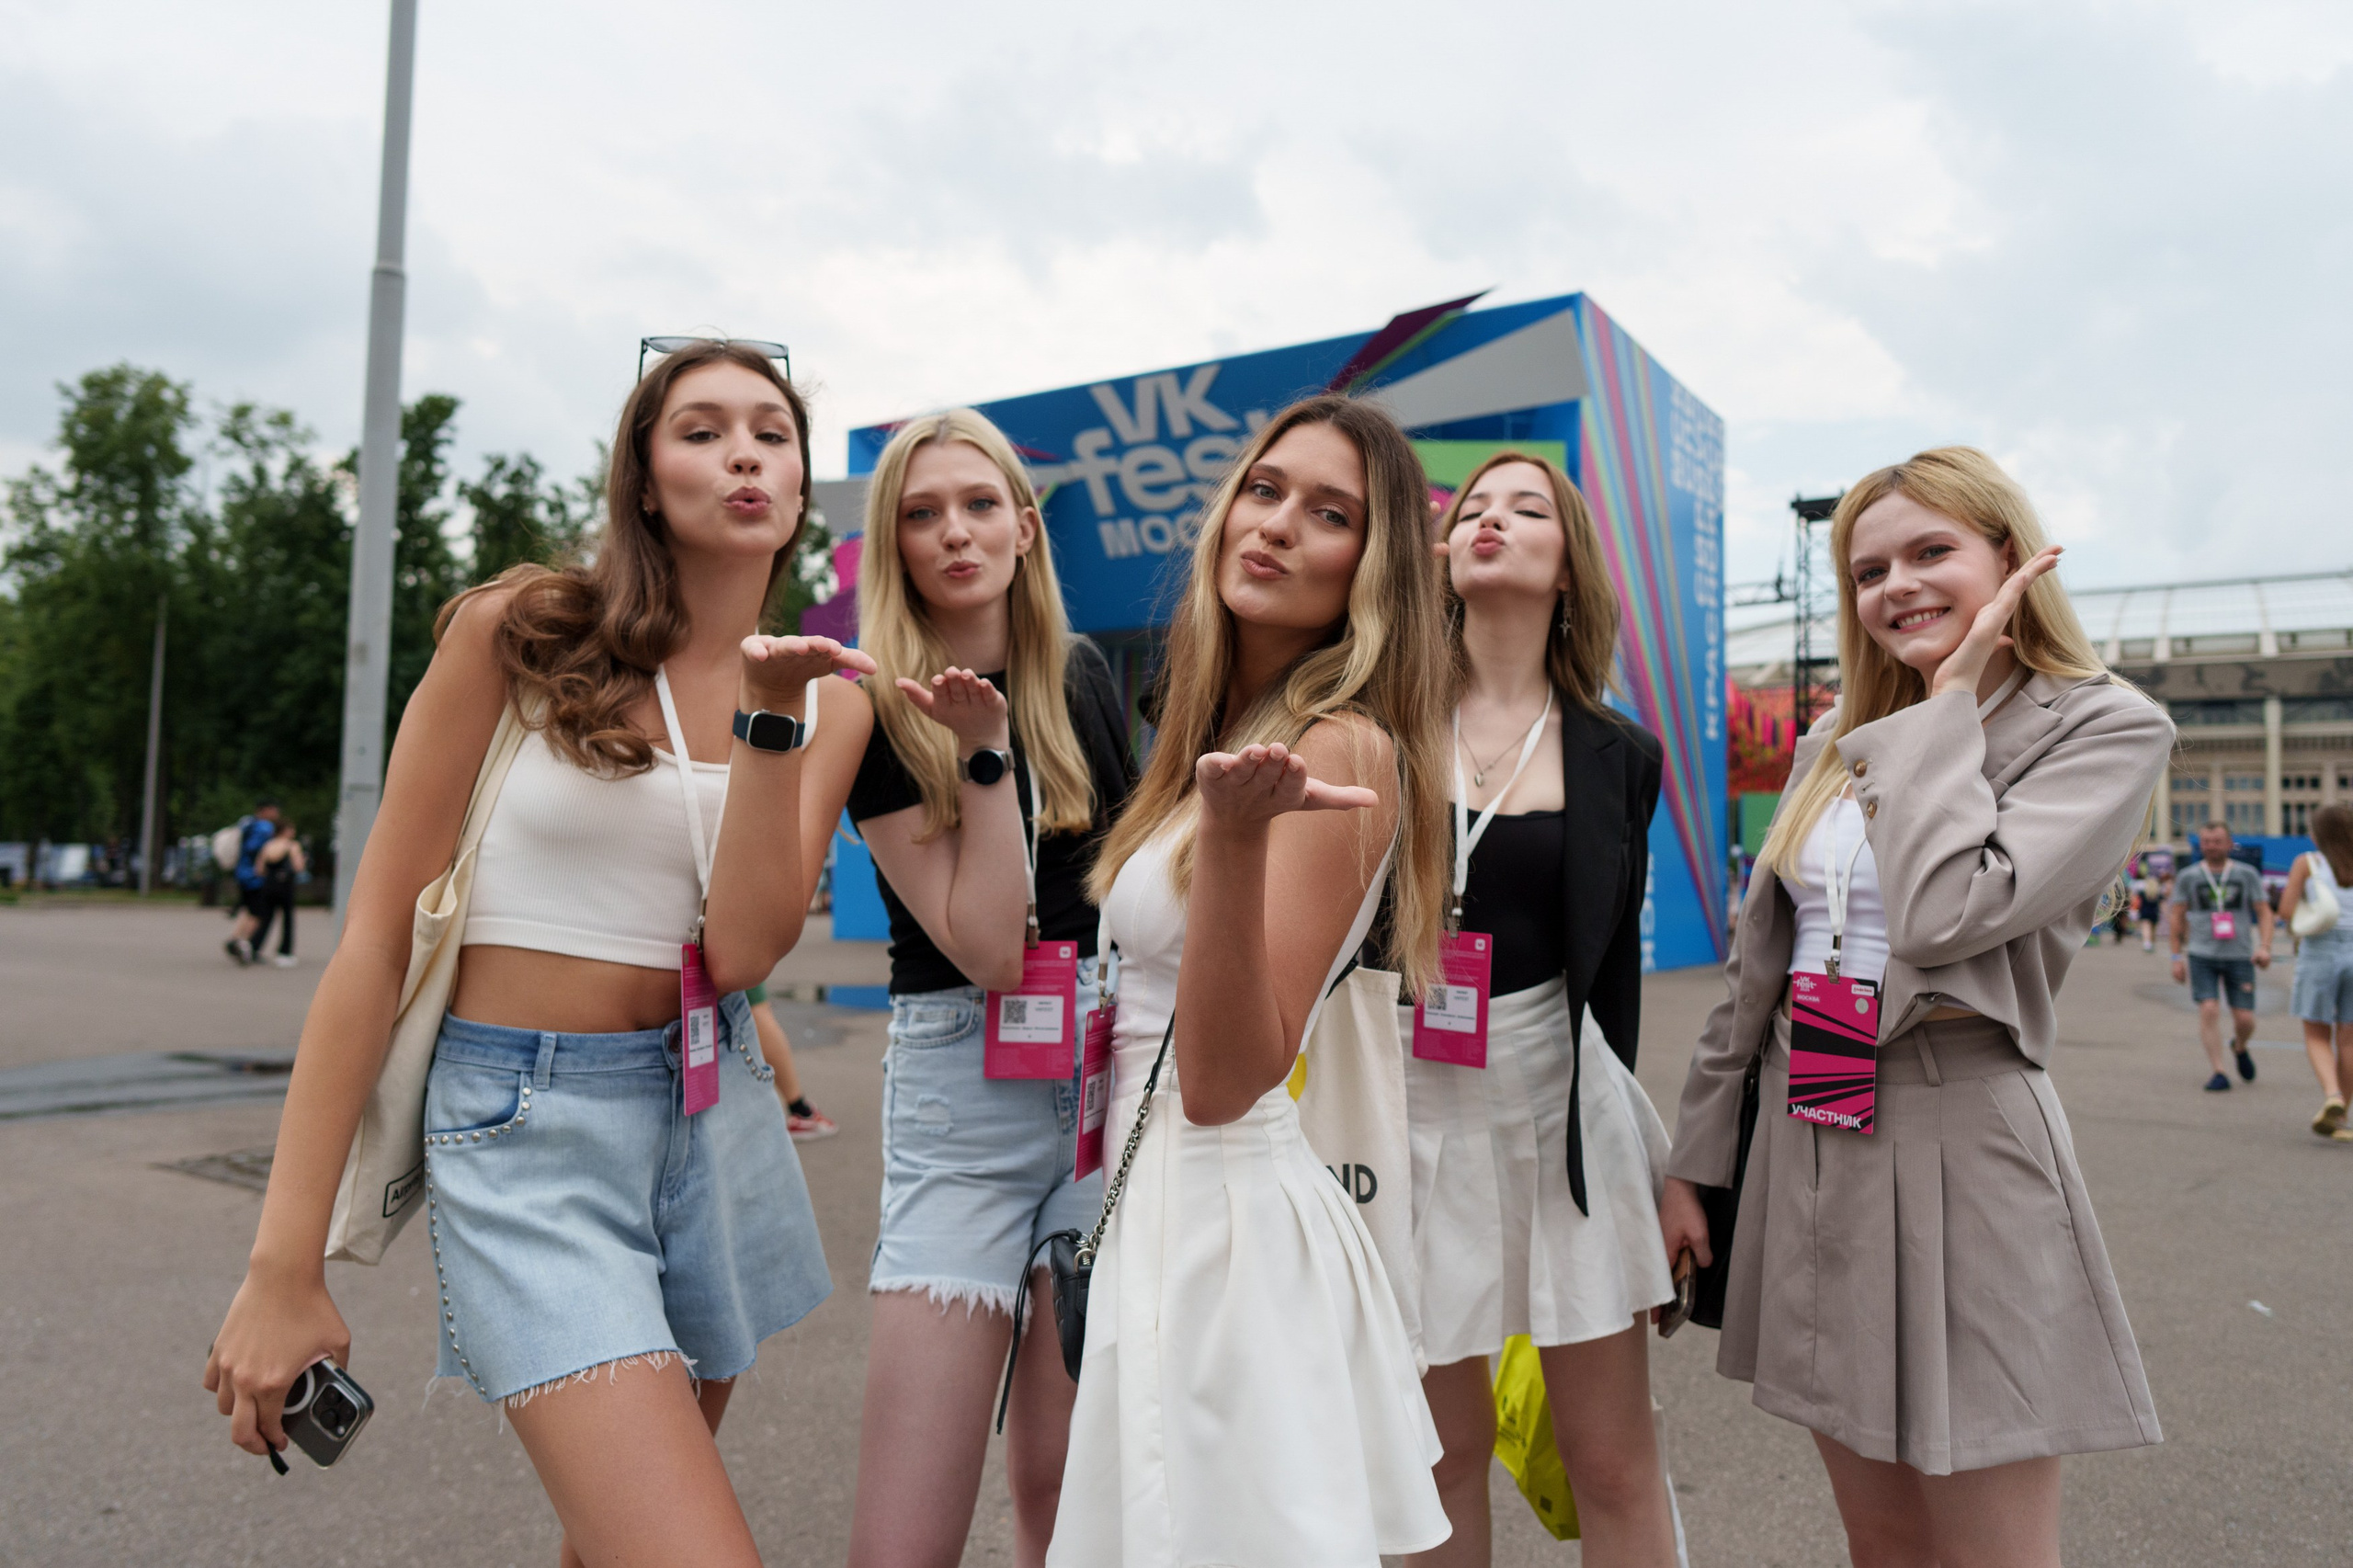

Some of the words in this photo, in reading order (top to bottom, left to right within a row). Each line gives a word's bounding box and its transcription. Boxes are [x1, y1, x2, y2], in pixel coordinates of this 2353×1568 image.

[1091, 364, 1240, 445] VK
[1099, 513, 1200, 560] МОС
[1791, 1103, 1862, 1130] УЧАСТНИК
